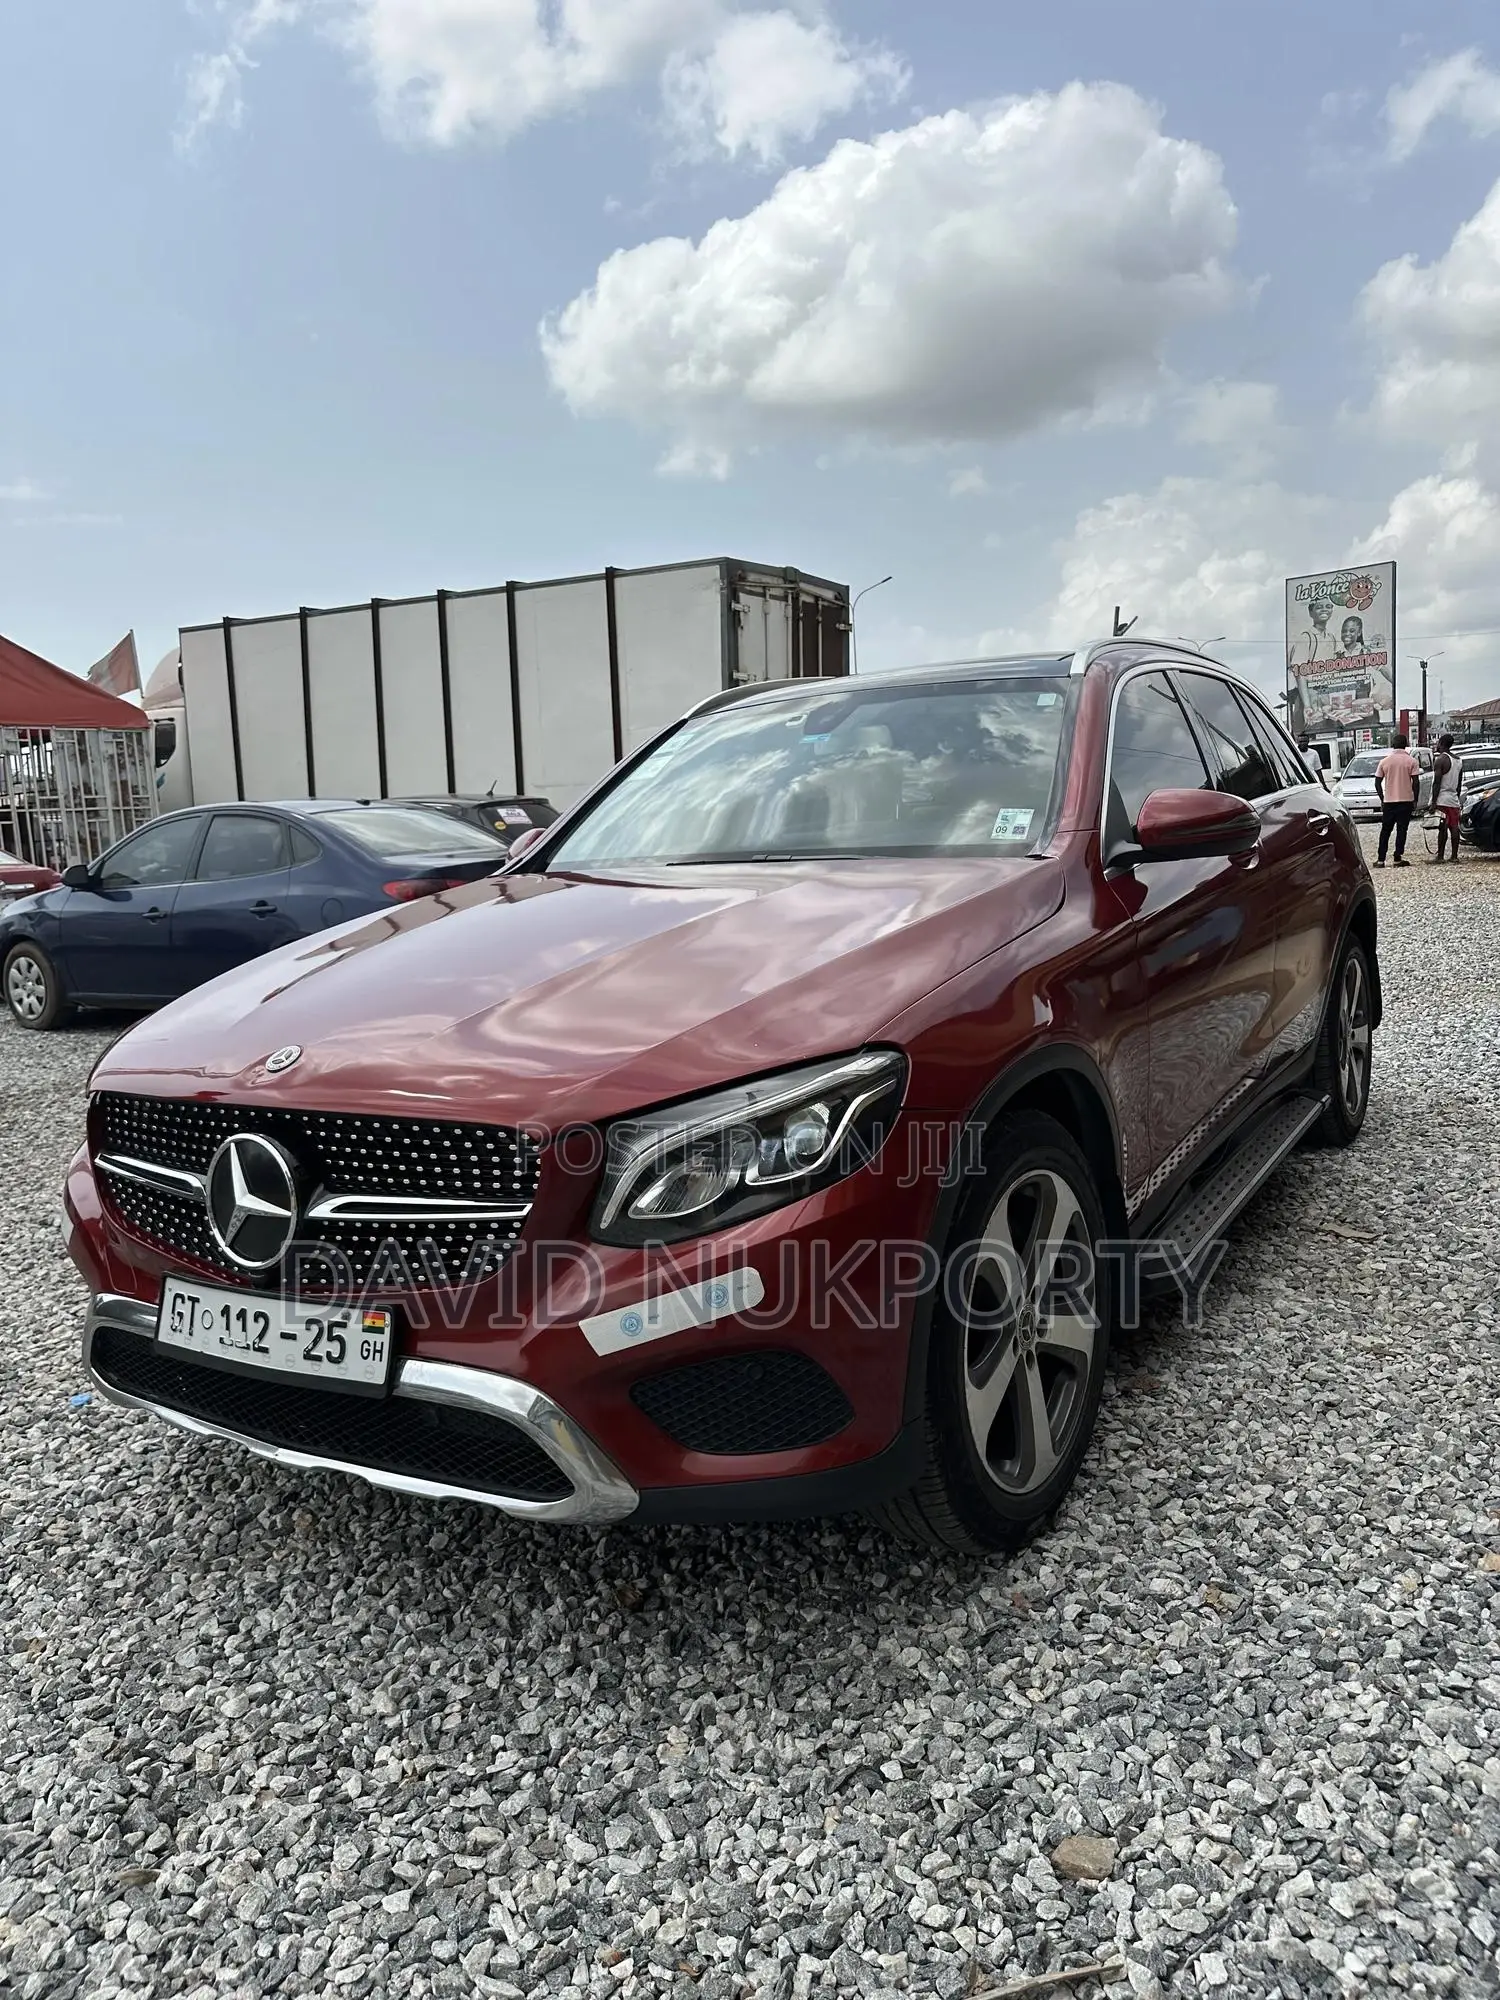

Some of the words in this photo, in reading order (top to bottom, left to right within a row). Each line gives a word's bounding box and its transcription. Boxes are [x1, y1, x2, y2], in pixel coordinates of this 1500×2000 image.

[1325, 652, 1387, 672] DONATION
[995, 825, 1008, 834] 09
[170, 1292, 200, 1336] GT
[360, 1339, 385, 1363] GH
